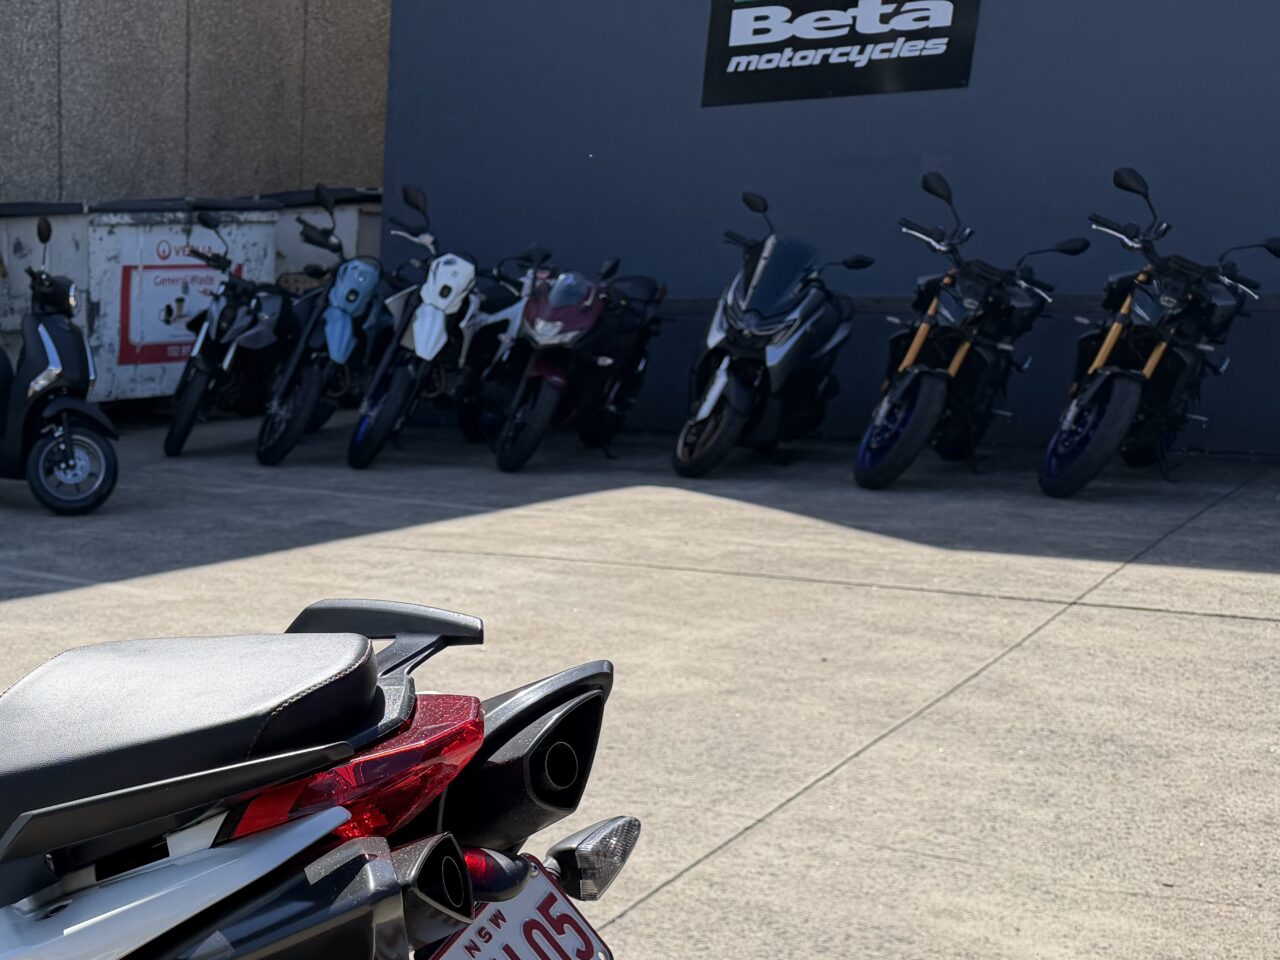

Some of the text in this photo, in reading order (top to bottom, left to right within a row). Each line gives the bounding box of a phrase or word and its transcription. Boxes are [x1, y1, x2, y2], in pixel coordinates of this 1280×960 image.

[728, 0, 954, 46] Beta
[726, 37, 950, 72] motorcycles
[464, 908, 507, 959] NSW
